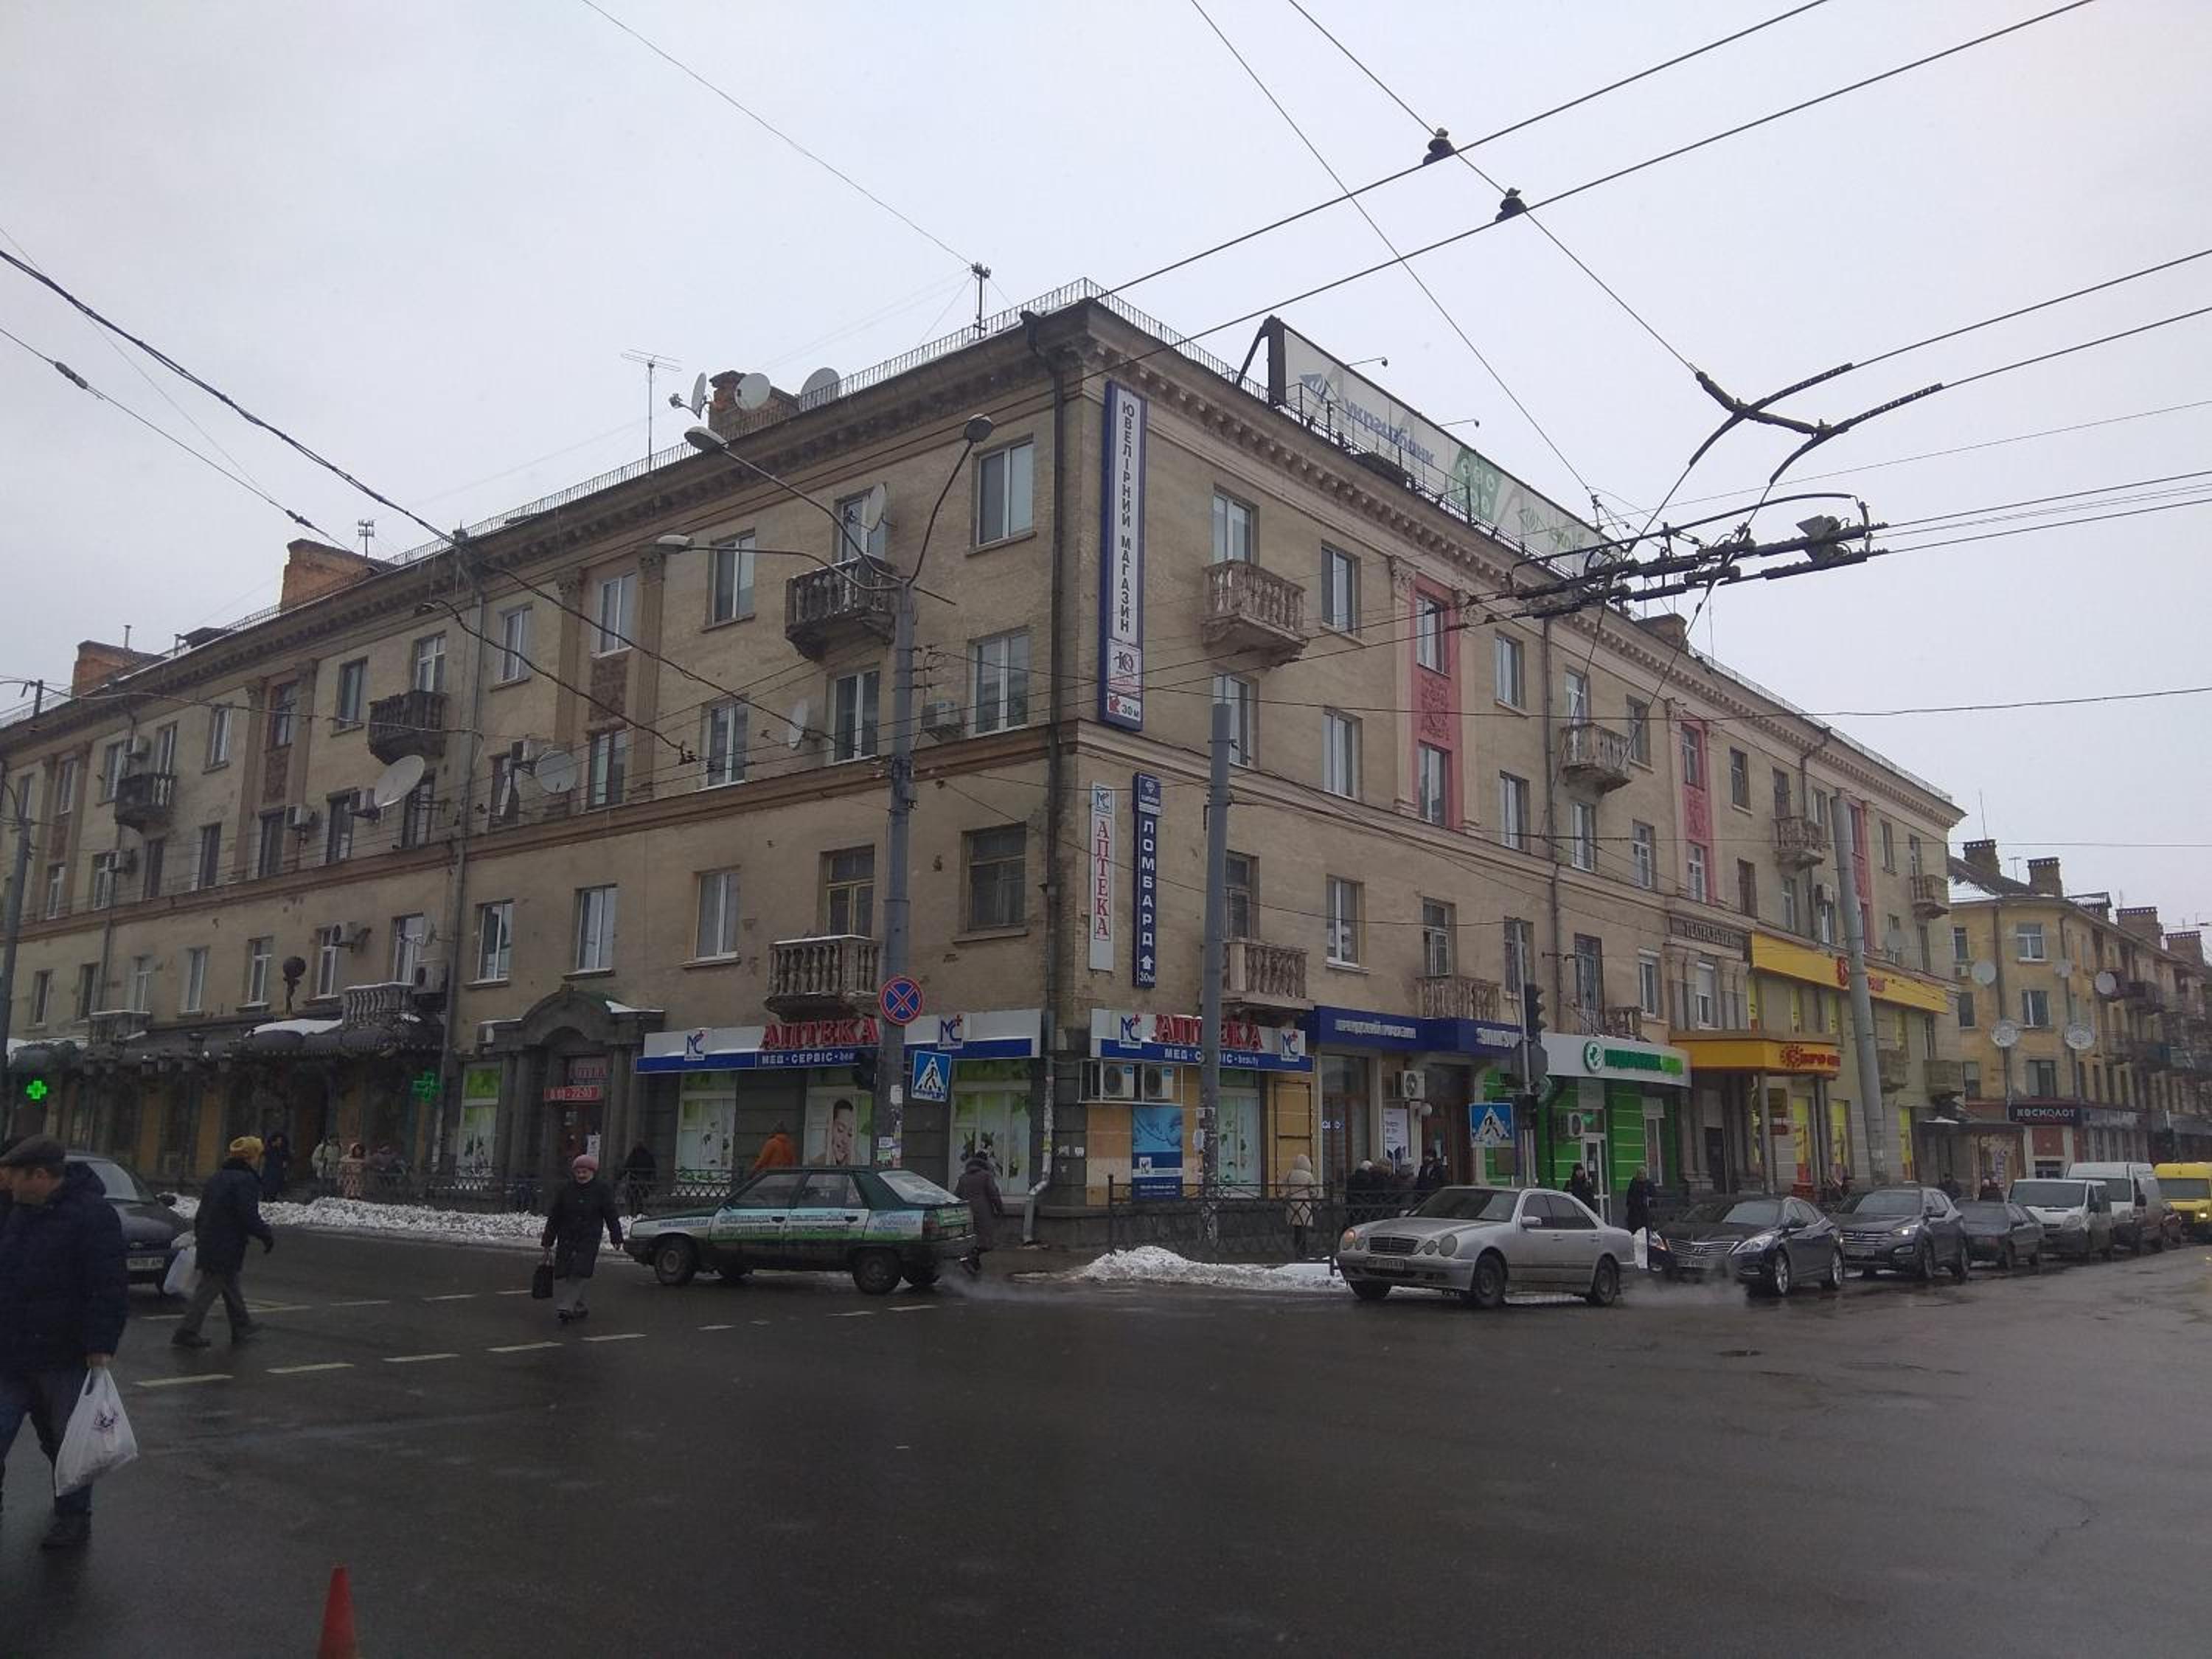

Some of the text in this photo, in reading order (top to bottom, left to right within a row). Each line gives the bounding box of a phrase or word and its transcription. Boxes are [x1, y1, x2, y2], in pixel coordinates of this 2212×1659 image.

[1120, 401, 1135, 632] ЮВЕЛІРНИЙ МАГАЗИН
[1096, 821, 1110, 936] АПТЕКА
[1142, 821, 1155, 947] ЛОМБАРД
[759, 1018, 879, 1050] АПТЕКА
[1155, 1015, 1263, 1051] АПТКА
[762, 1053, 833, 1065] МЕД СЕРВІС
[1164, 1048, 1187, 1060] МЕД
